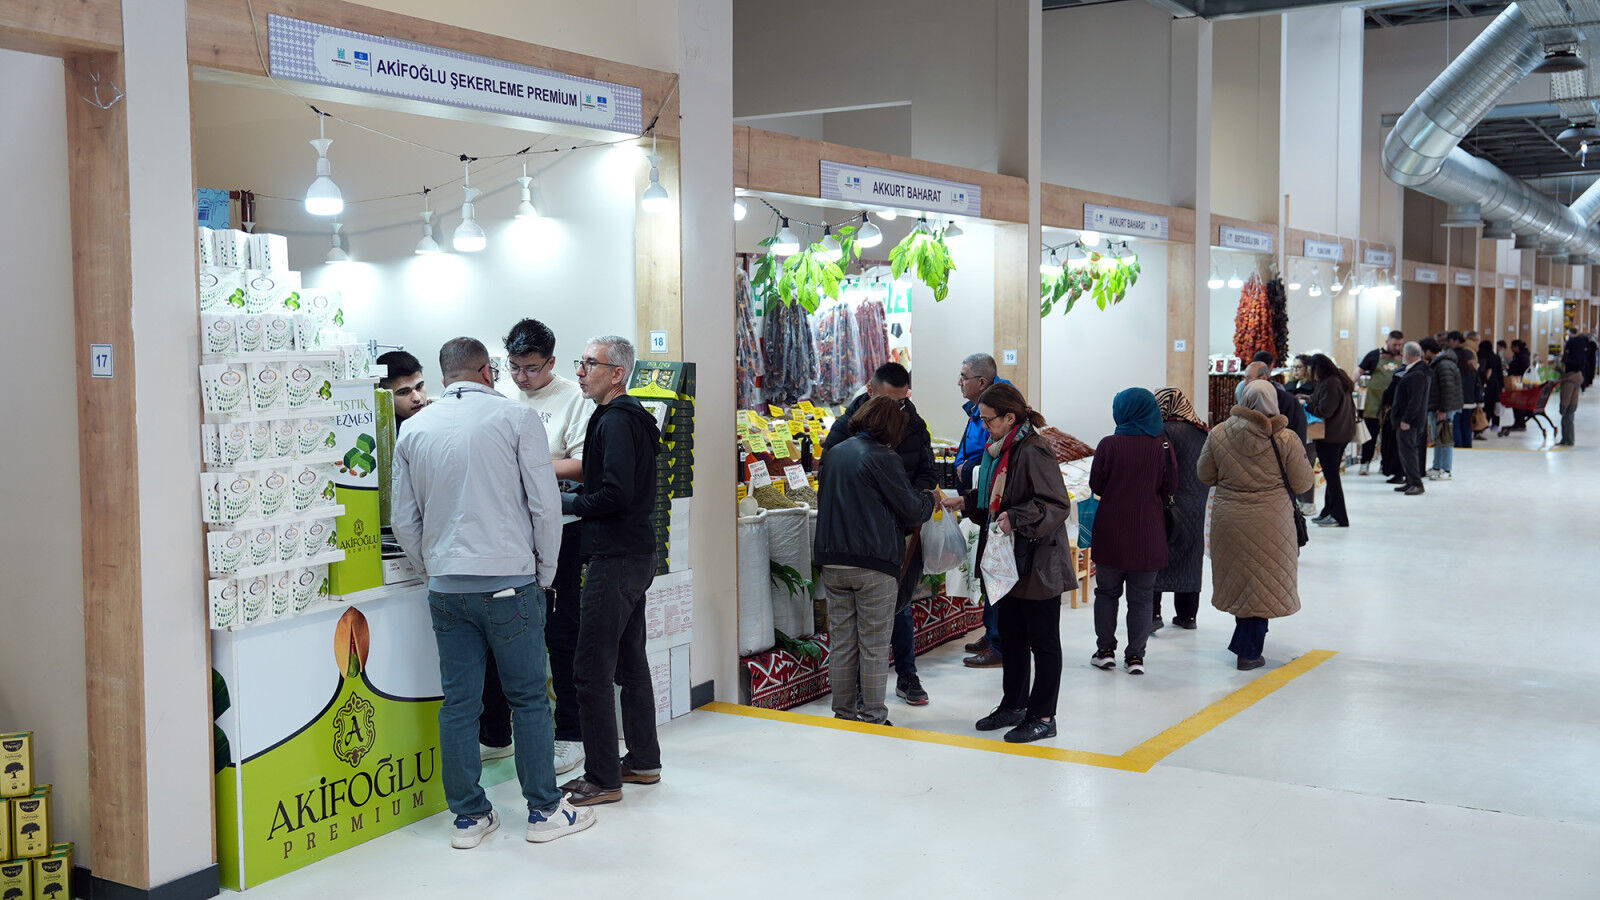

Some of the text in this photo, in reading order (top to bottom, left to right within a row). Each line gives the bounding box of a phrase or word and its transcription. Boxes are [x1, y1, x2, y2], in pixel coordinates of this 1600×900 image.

[377, 59, 578, 107] AKİFOĞLU ŞEKERLEME PREMİUM
[873, 181, 942, 203] AKKURT BAHARAT
[1109, 216, 1146, 231] AKKURT BAHARAT
[654, 337, 664, 346] 18
[96, 354, 107, 367] 17
[336, 410, 373, 427] EZMESİ
[339, 534, 379, 550] AKİFOĞLU
[344, 715, 364, 746] A
[267, 747, 435, 841] AKİFOĞLU
[283, 790, 424, 859] PREMIUM
